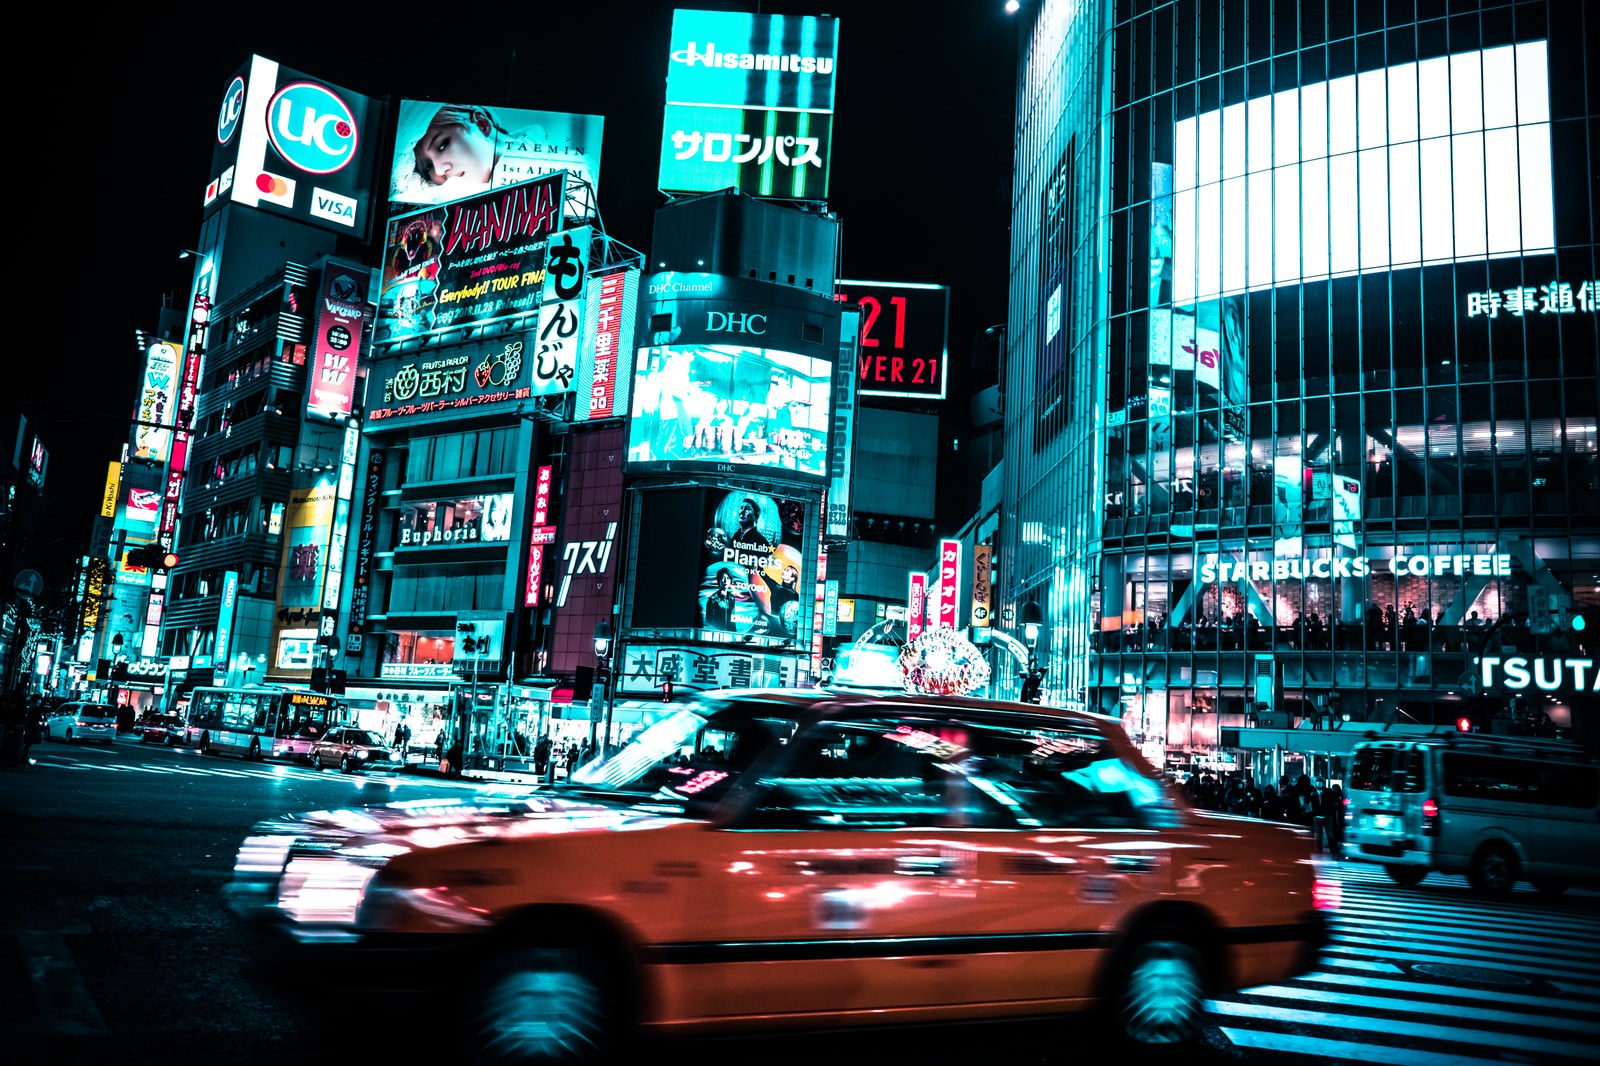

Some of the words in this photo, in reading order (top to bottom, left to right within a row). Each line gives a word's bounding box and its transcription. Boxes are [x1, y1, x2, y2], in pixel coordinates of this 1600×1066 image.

[671, 41, 833, 75] Hisamitsu
[278, 97, 352, 157] UC
[505, 141, 585, 156] TAEMIN
[671, 130, 822, 169] サロンパス
[503, 164, 520, 173] 1st
[526, 166, 582, 178] ALBM
[317, 196, 354, 220] VISA
[445, 184, 558, 255] WANIMA
[439, 279, 490, 303] Everybody!!
[492, 275, 520, 292] TOUR
[649, 282, 671, 295] DHC
[672, 281, 713, 293] Channel
[1467, 280, 1600, 319] 時事通信
[537, 234, 584, 389] もんじゃ
[705, 311, 768, 335] DHC
[589, 278, 618, 410] 三千里薬品
[419, 367, 467, 397] 西村
[912, 358, 937, 384] 21
[717, 464, 736, 473] DHC
[401, 526, 478, 547] Euphoria
[732, 540, 768, 553] teamLab
[723, 548, 783, 571] Planets
[1200, 556, 1370, 583] STARBUCKS
[1388, 553, 1511, 577] COFFEE
[735, 581, 768, 593] TOYOSU
[1473, 656, 1600, 691] TSUT
